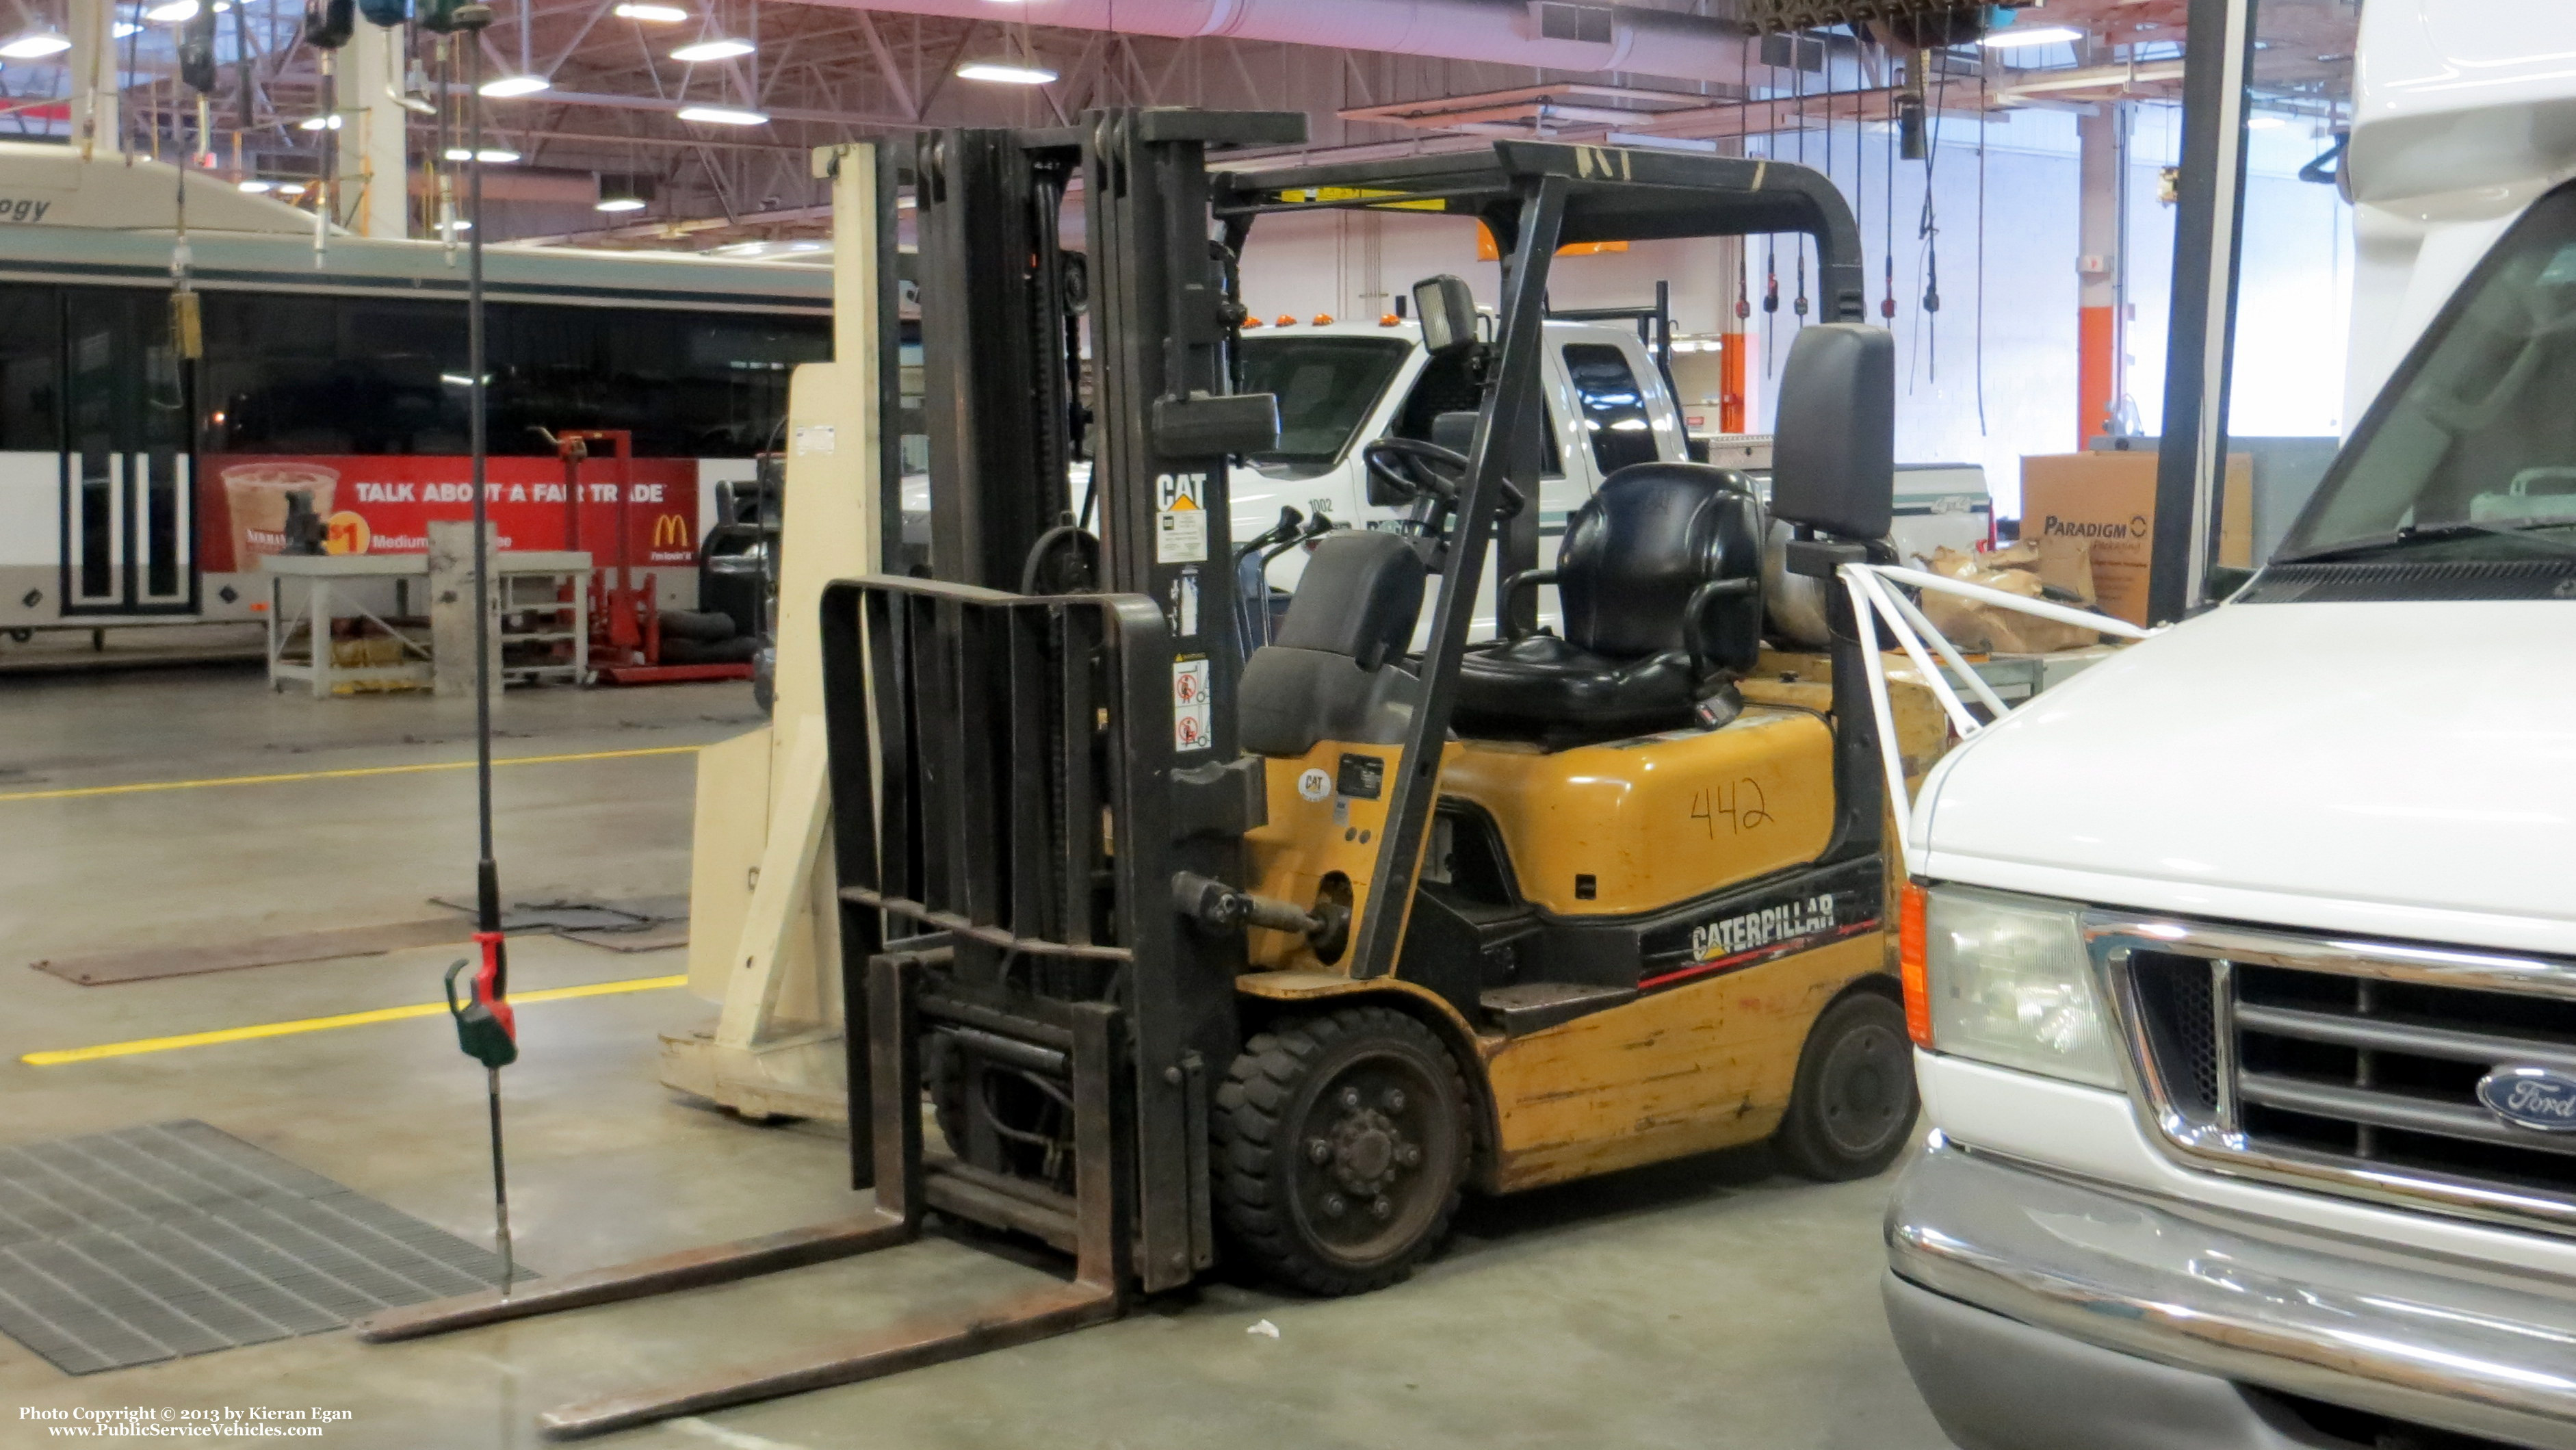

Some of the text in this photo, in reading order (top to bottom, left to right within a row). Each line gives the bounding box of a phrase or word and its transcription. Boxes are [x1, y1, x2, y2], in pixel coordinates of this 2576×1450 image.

[356, 482, 416, 503] TALK
[422, 482, 503, 503] ABOT
[509, 482, 527, 502] A
[1156, 474, 1207, 512] CAT
[1309, 498, 1333, 513] 1002
[2044, 515, 2127, 539] PARADIGM
[373, 535, 429, 548] Medium
[1305, 775, 1323, 790] CAT
[1691, 777, 1775, 840] 442
[1692, 893, 1835, 962] CATERPILLAR
[2508, 1080, 2576, 1117] Ford
